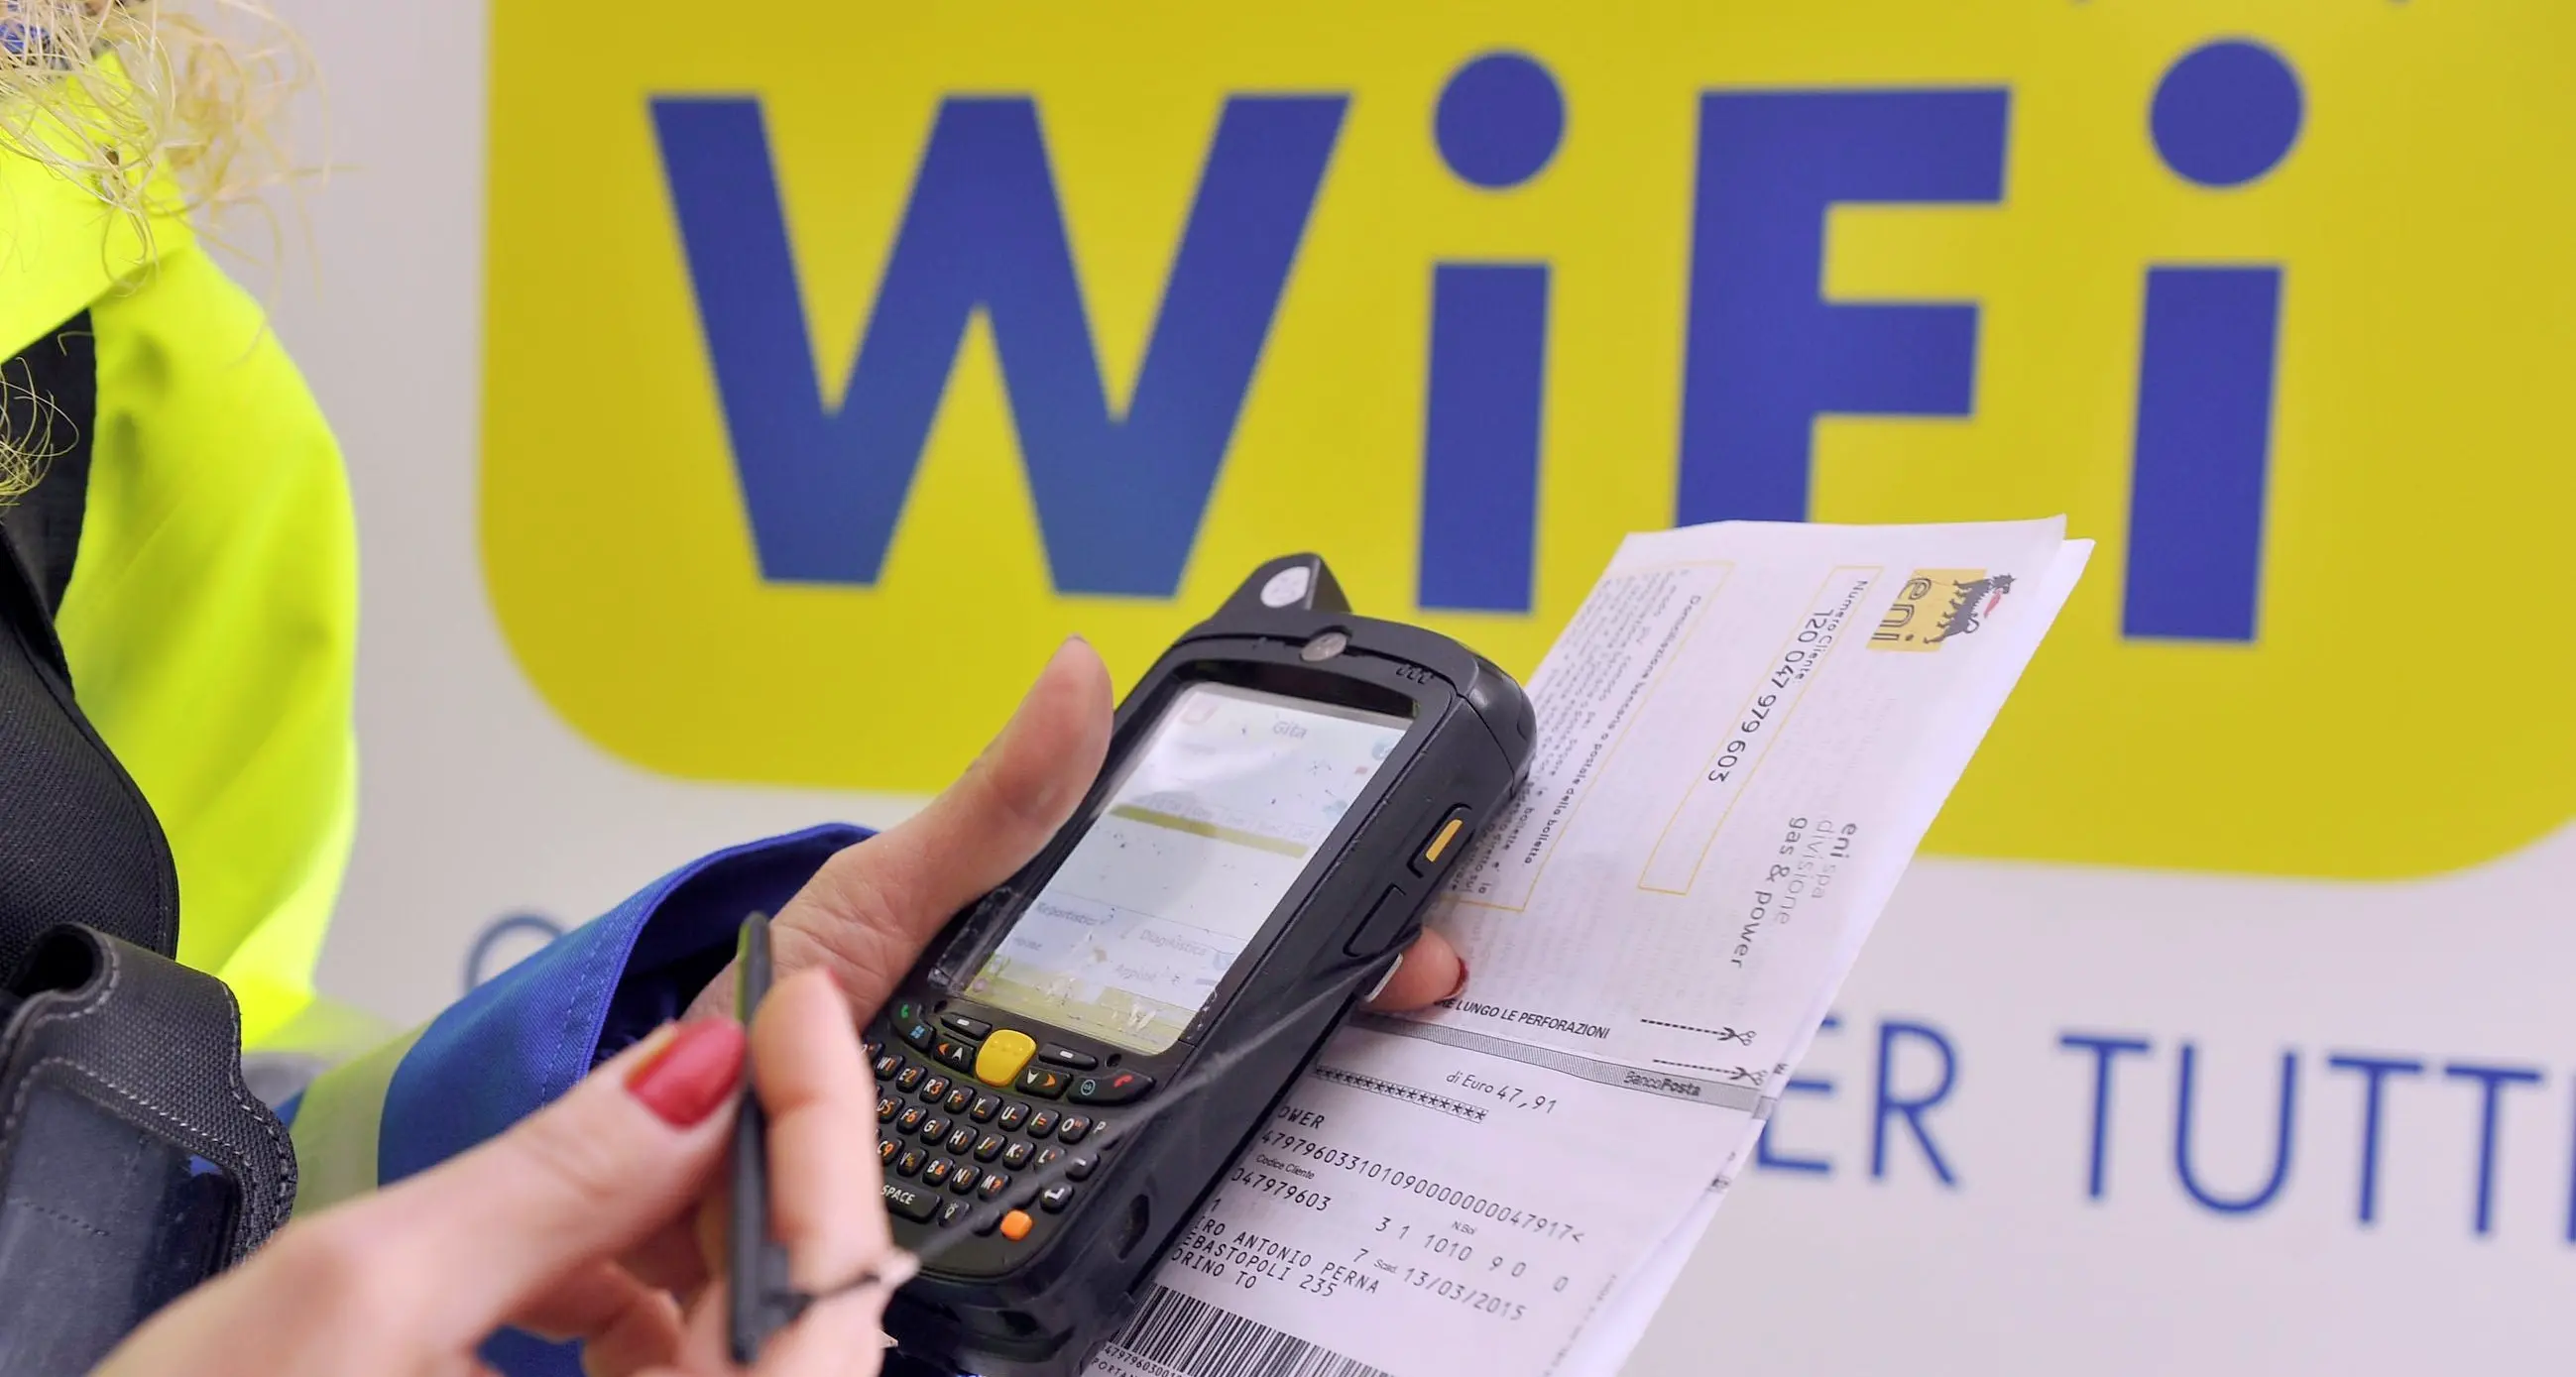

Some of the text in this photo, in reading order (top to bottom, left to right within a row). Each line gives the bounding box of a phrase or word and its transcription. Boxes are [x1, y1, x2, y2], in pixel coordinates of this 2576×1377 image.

[646, 37, 2307, 644] WiFi
[1827, 580, 1869, 631] Numero
[1871, 577, 1932, 641] eni
[1707, 609, 1833, 782] 120 047 979 603
[1272, 721, 1308, 740] Gita
[1572, 742, 1602, 784] postale
[1553, 786, 1576, 816] della
[1774, 820, 1834, 924] divisione
[1811, 823, 1858, 898] eni spa
[1730, 817, 1808, 970] gas & power
[1456, 999, 1500, 1018] LUNGO
[1500, 1008, 1519, 1021] LE
[1518, 1011, 1611, 1040] PERFORAZIONI
[1446, 1070, 1558, 1114] di Euro 47,91
[1623, 1071, 1701, 1096] BancoPosta
[1276, 1105, 1326, 1129] OWER
[1255, 1153, 1316, 1180] Codice Cliente
[880, 1185, 915, 1205] SPACE
[1171, 1248, 1257, 1289] ORINO TO
[1233, 1231, 1312, 1268] ANTONIO
[1321, 1261, 1380, 1295] PERNA
[1424, 1233, 1473, 1262] 1010
[1299, 1273, 1339, 1298] 235
[1352, 1248, 1369, 1263] 7
[1403, 1267, 1528, 1321] 13/03/2015
